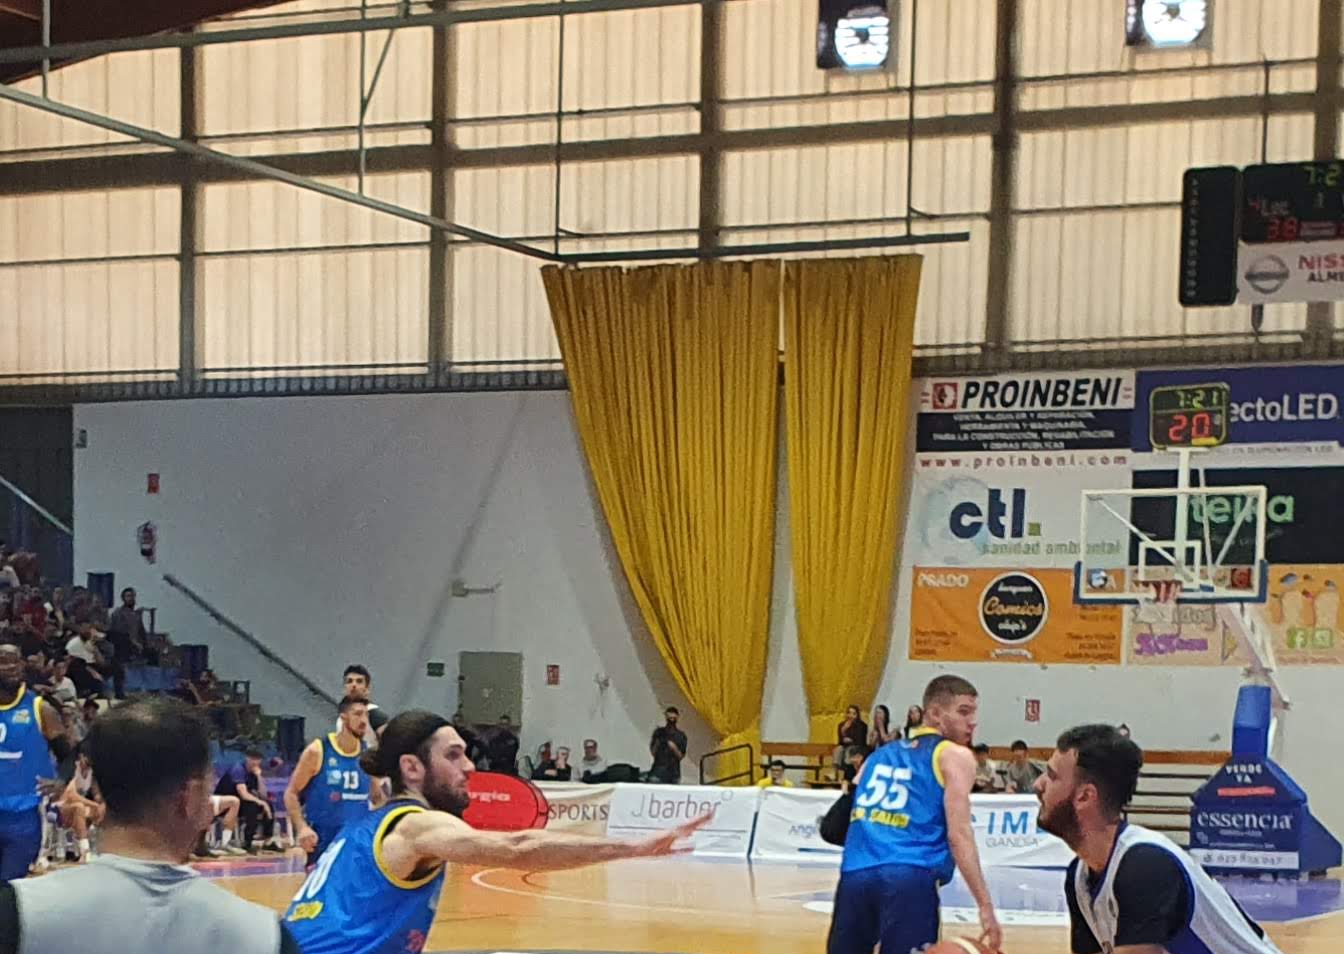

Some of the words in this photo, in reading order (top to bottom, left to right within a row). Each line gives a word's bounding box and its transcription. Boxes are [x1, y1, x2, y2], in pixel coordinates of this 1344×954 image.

[961, 378, 1122, 408] PROINBENI
[1230, 394, 1340, 423] ectoLED
[1168, 412, 1210, 441] 20
[920, 453, 1128, 470] www.proinbeni.com
[342, 771, 359, 789] 13
[857, 763, 913, 810] 55
[987, 811, 1048, 836] IM
[1197, 812, 1291, 829] essencia
